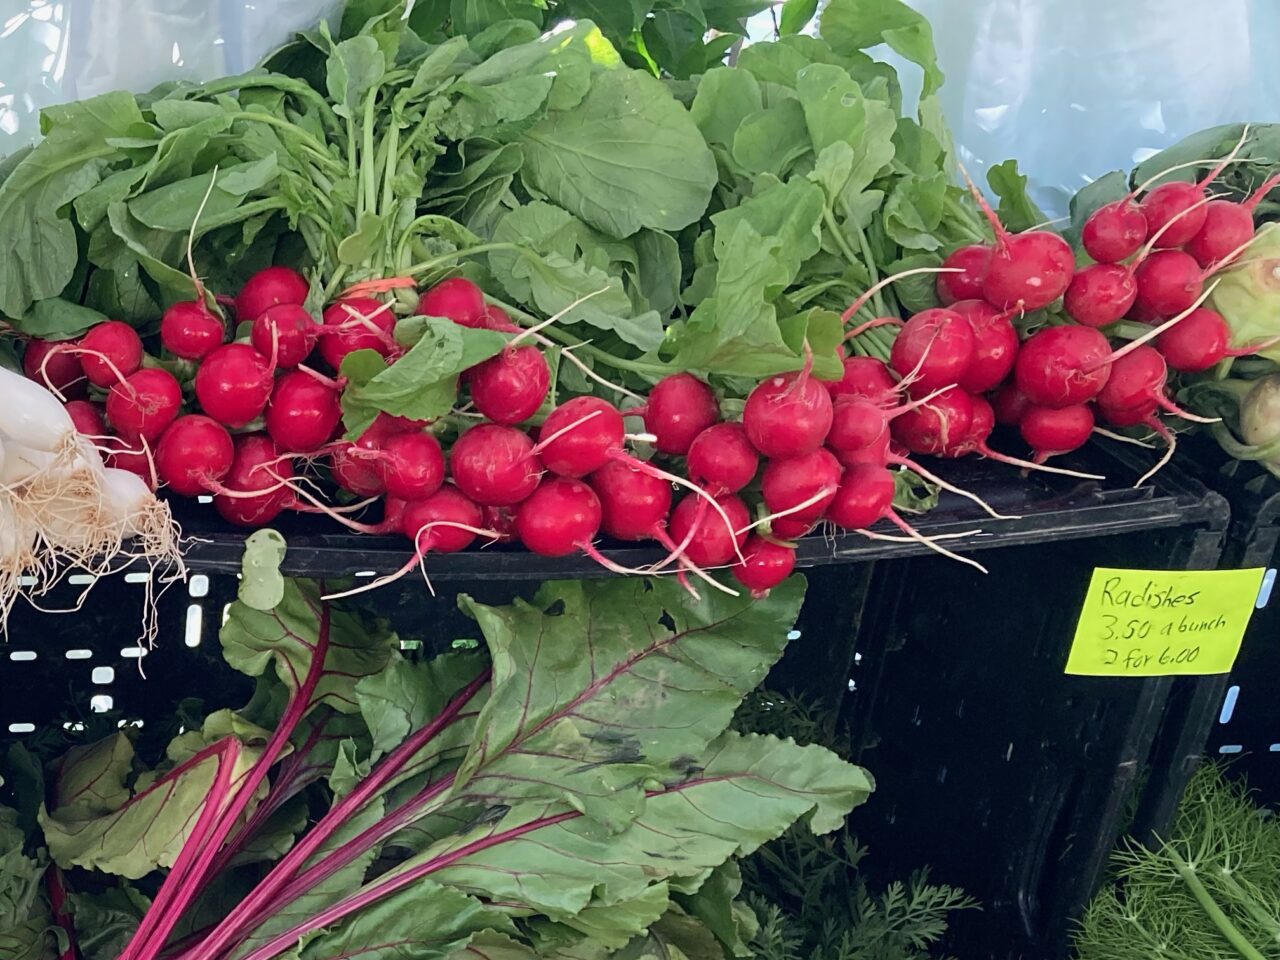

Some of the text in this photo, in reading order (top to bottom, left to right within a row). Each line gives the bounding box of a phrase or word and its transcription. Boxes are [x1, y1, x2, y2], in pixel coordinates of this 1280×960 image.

[1101, 577, 1201, 609] Radishes
[1100, 614, 1151, 640] 3.50
[1178, 614, 1226, 633] bunch
[1103, 646, 1200, 670] 2 for 6.00
